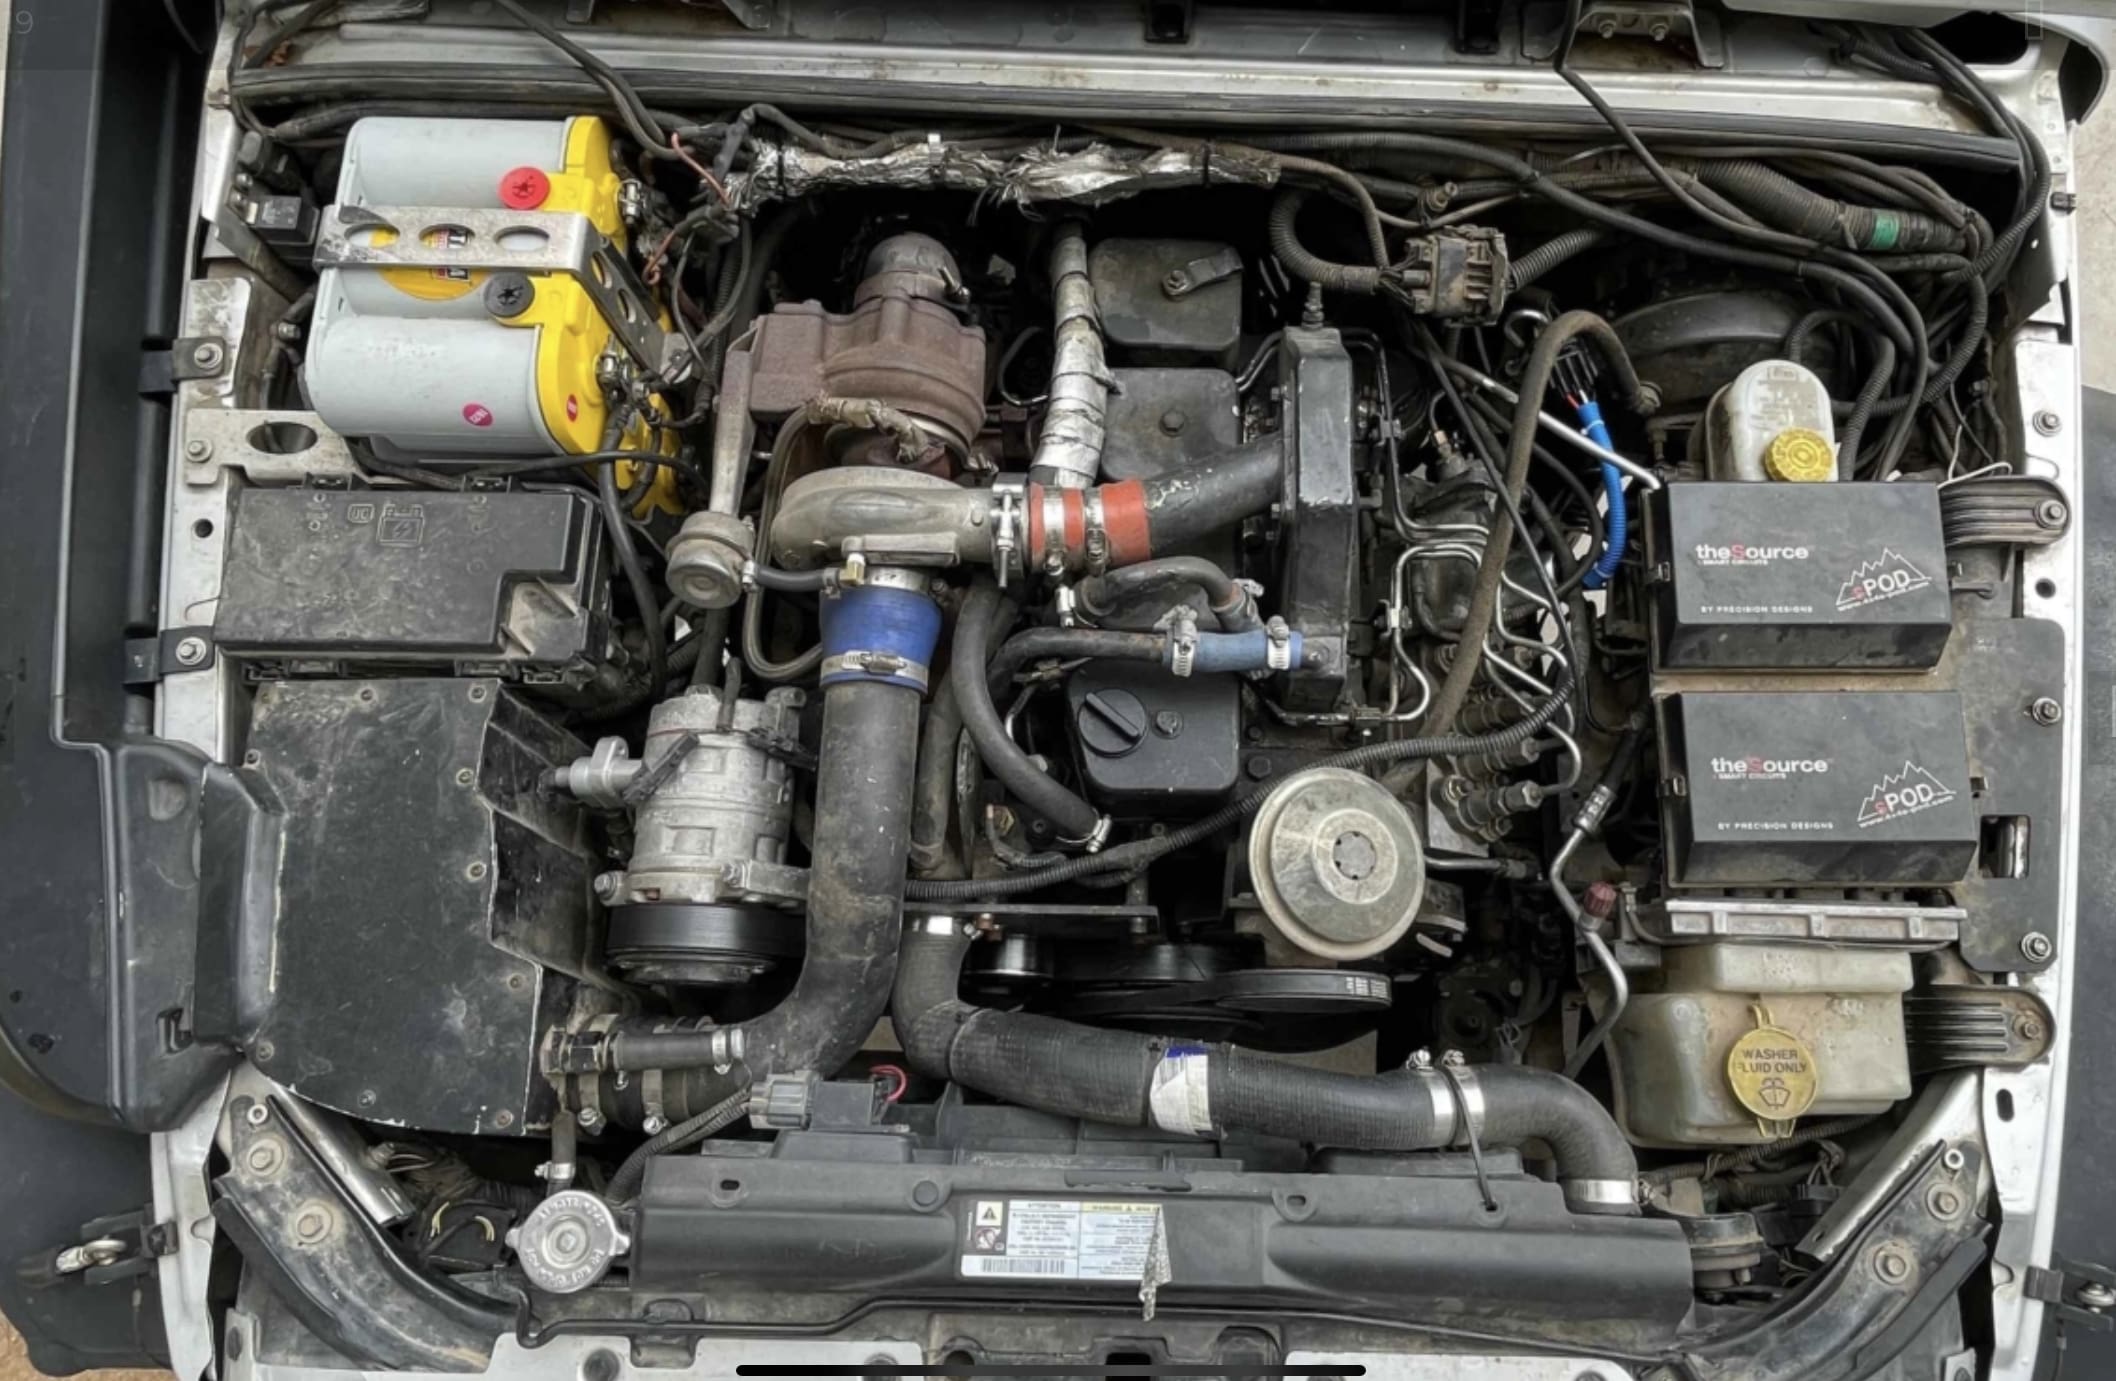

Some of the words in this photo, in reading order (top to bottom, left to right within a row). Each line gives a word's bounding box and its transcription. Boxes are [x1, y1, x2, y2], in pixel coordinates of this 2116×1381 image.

[1695, 543, 1809, 560] theSource
[1700, 605, 1714, 614] BY
[1716, 605, 1768, 614] PRECISION
[1771, 605, 1814, 614] DESIGNS
[1710, 756, 1829, 773] theSource
[1717, 822, 1731, 831] BY
[1734, 822, 1788, 831] PRECISION
[1790, 822, 1834, 831] DESIGNS
[1742, 1048, 1798, 1060] WASHER
[1774, 1062, 1807, 1073] ONLY
